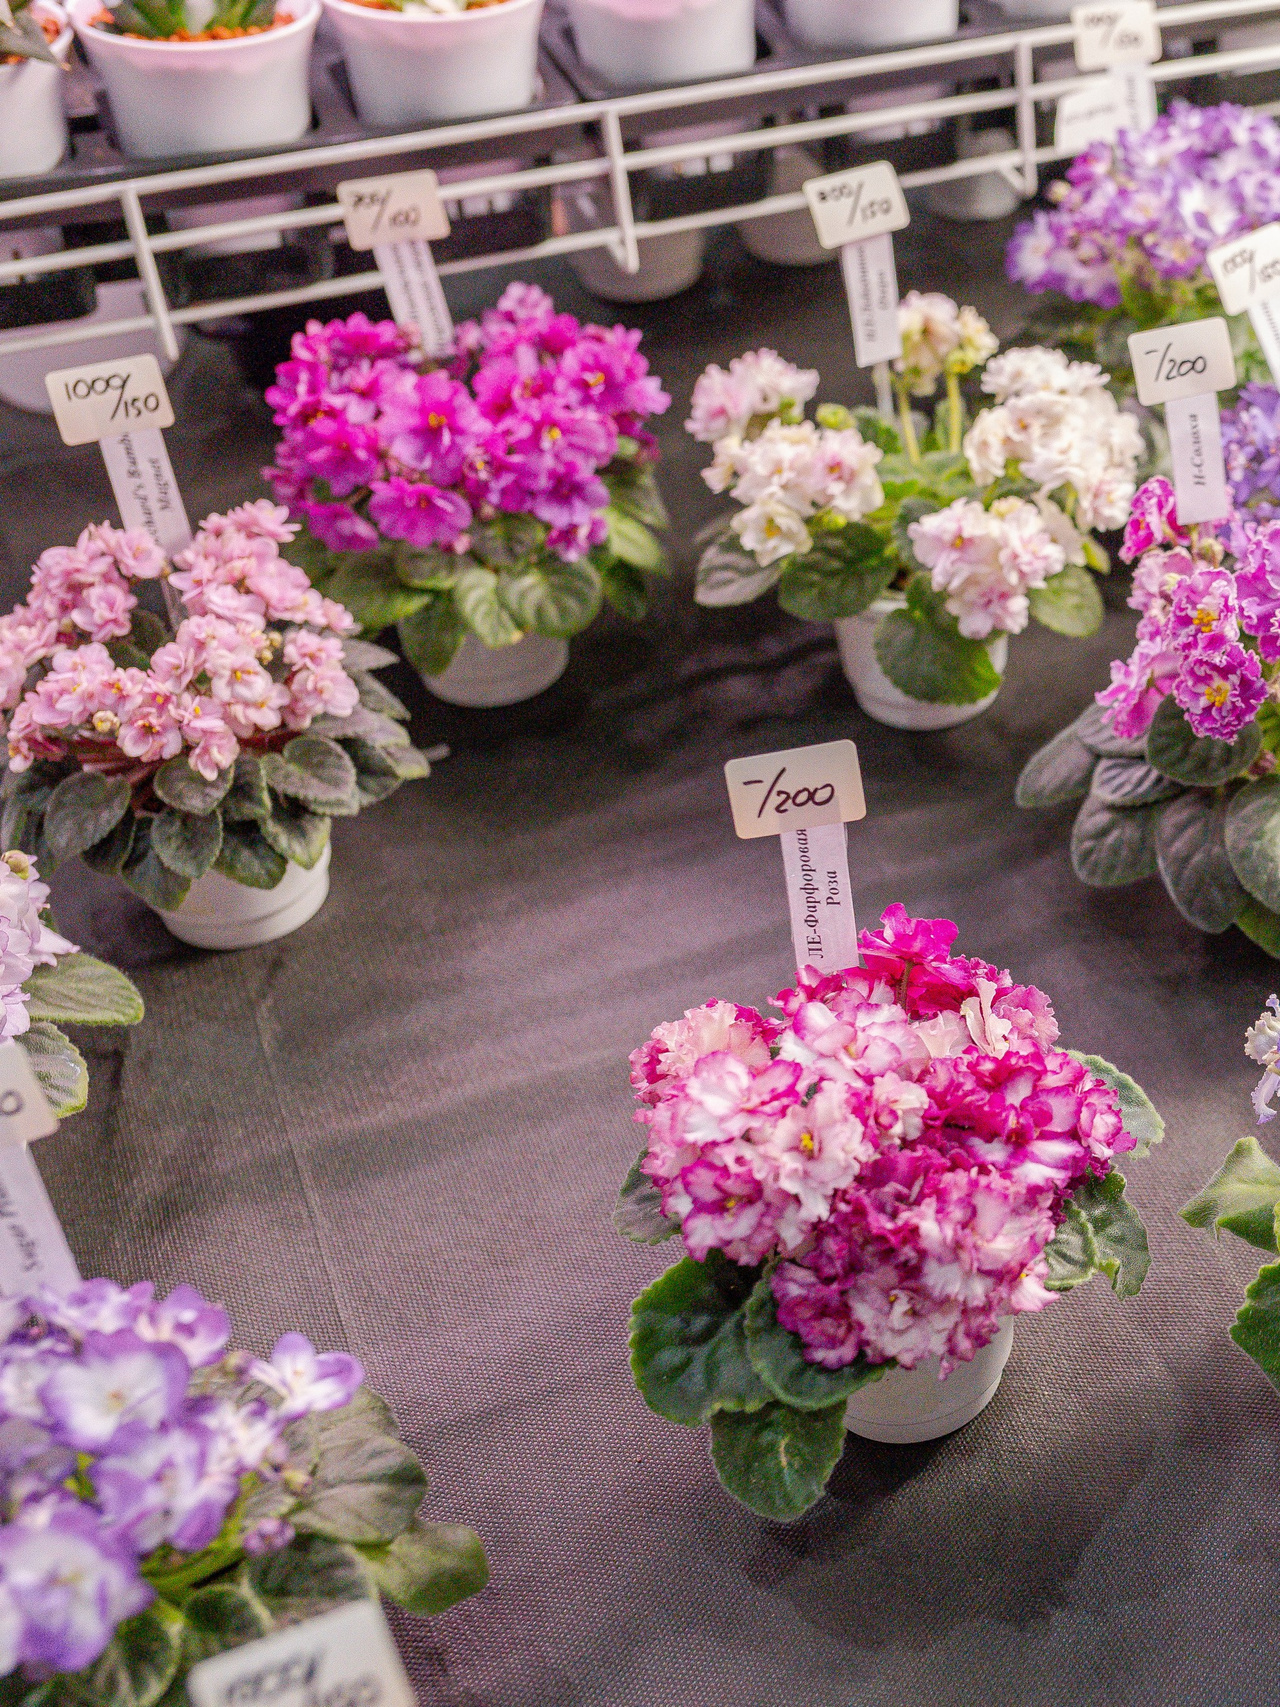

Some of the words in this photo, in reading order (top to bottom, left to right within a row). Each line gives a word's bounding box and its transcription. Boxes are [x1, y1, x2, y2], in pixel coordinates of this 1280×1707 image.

[65, 374, 160, 420] 1000/150
[796, 828, 824, 959] ЛЕ-Фарфоровая
[826, 870, 841, 907] Роза
